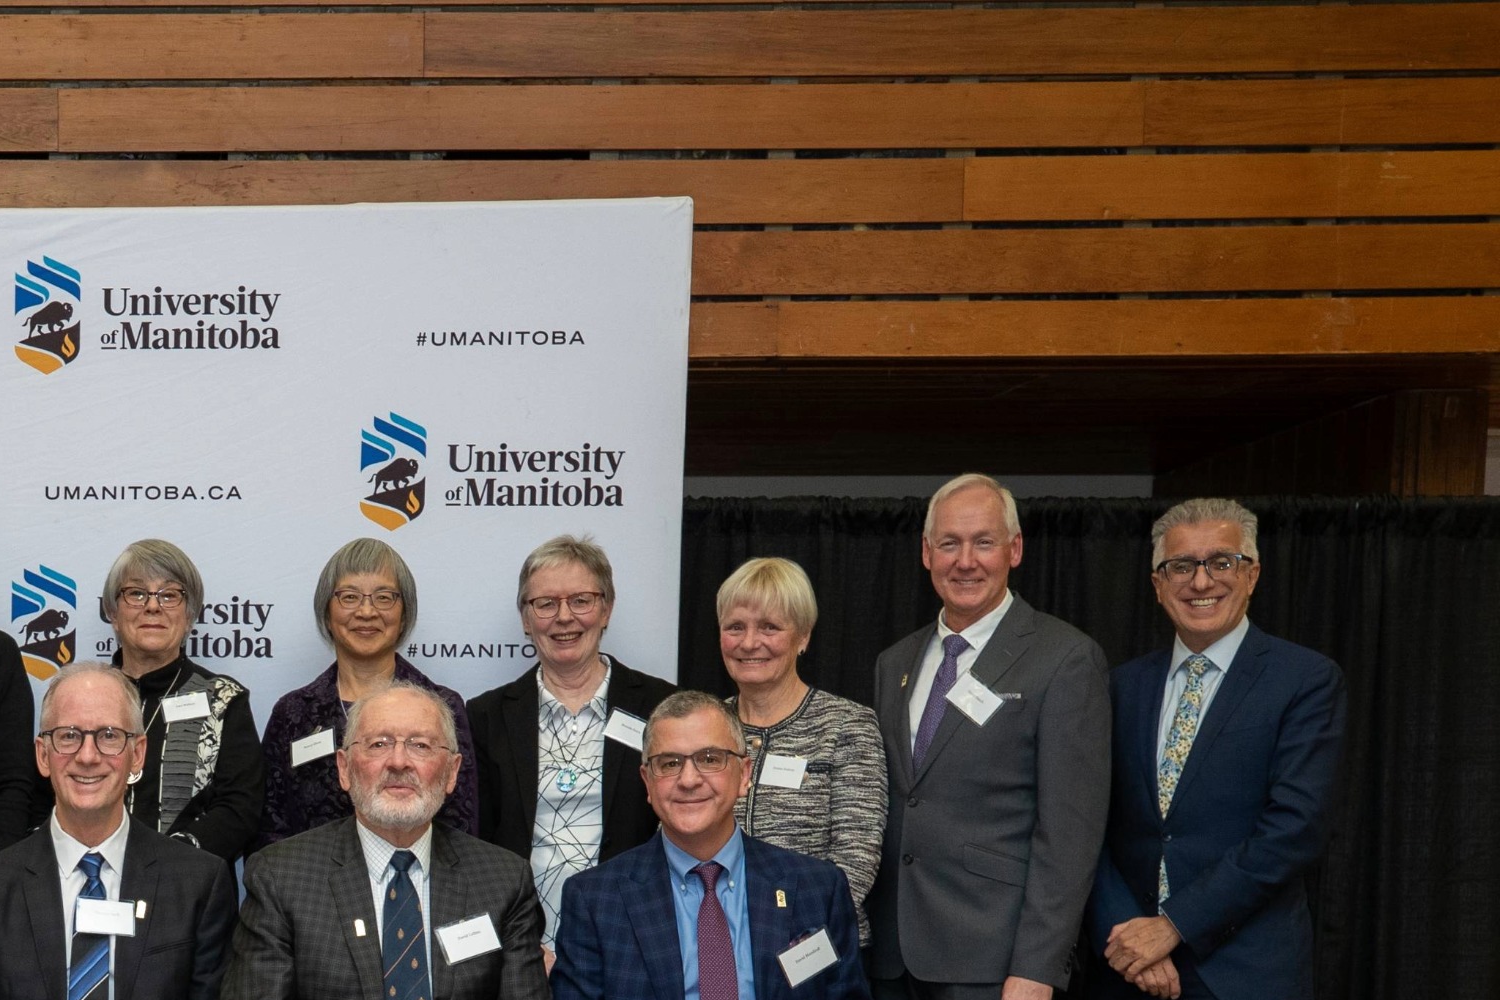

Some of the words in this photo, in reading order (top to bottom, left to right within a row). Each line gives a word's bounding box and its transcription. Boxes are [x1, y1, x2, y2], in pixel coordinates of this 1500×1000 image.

[102, 284, 282, 323] University
[100, 329, 119, 349] of
[119, 319, 282, 351] Manitoba
[415, 330, 586, 347] #UMANITOBA
[446, 442, 626, 481] University
[44, 484, 243, 501] UMANITOBA.CA
[444, 486, 463, 506] of
[464, 476, 624, 508] Manitoba
[95, 637, 114, 657] of
[407, 643, 537, 659] #UMANITO
